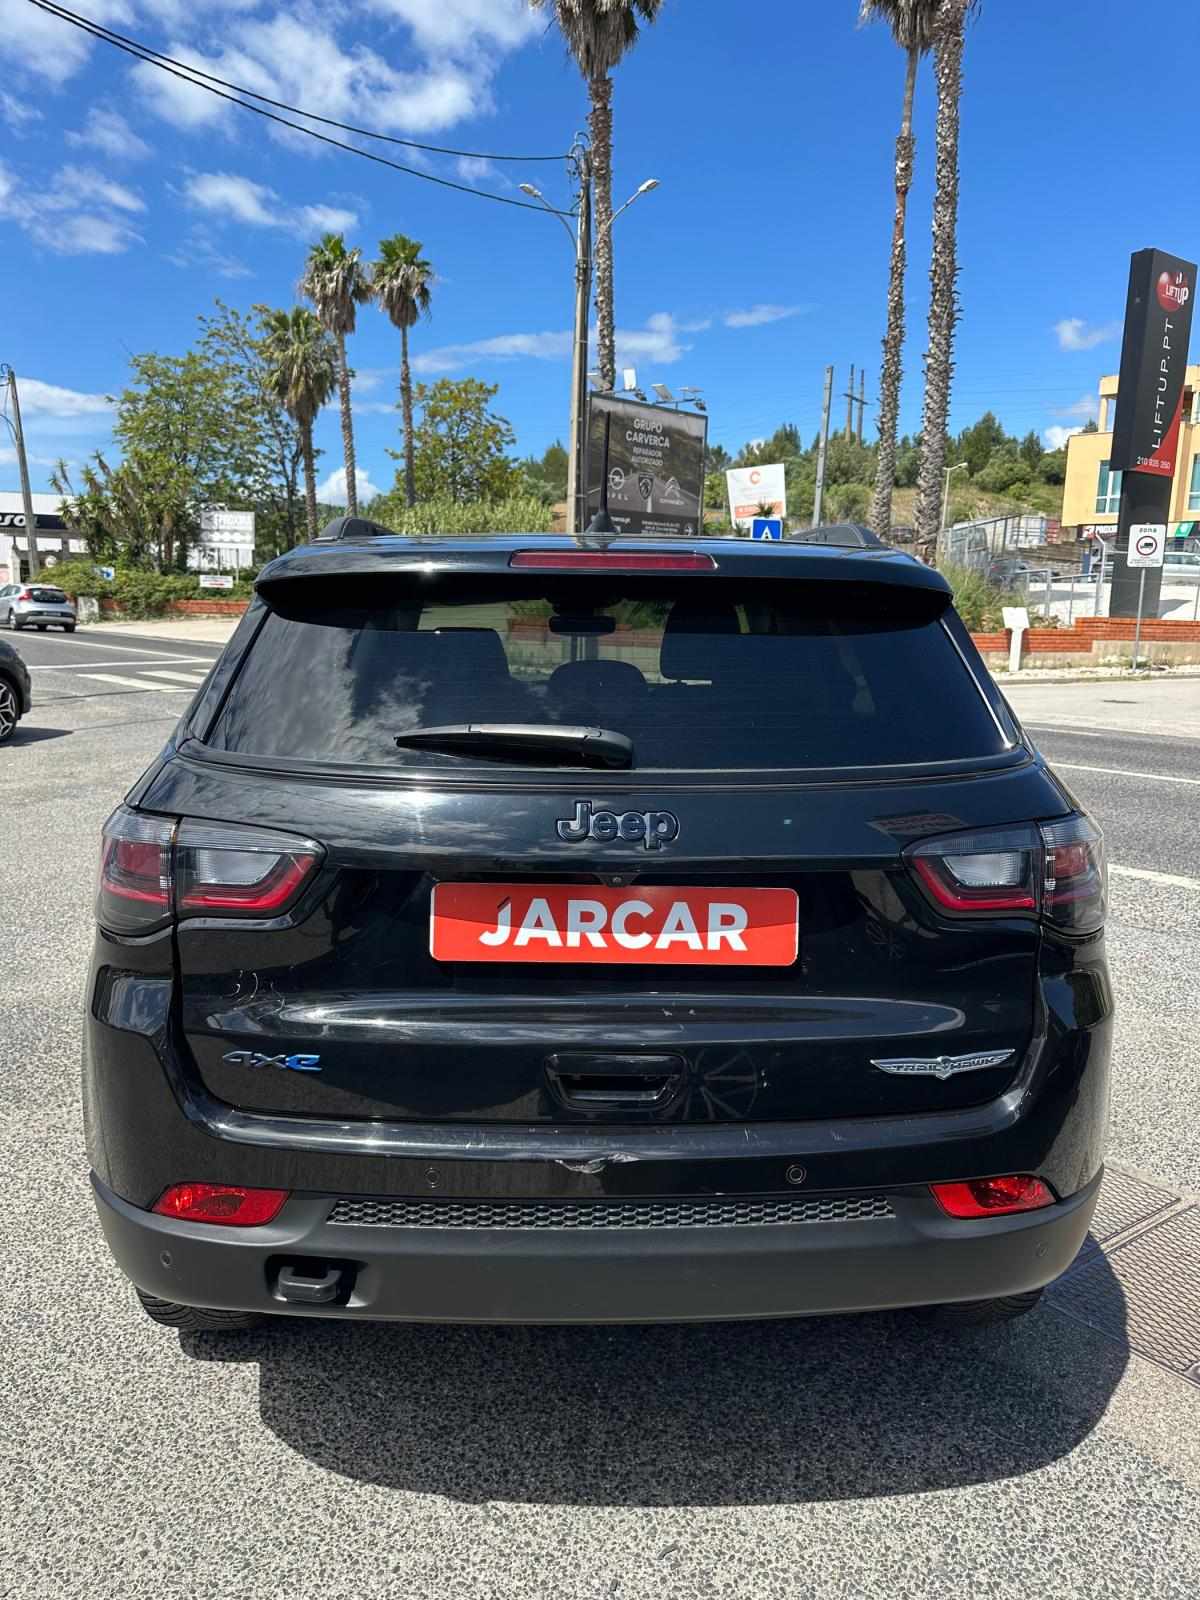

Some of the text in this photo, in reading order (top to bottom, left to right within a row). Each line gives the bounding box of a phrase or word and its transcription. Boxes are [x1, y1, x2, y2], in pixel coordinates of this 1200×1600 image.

[1166, 284, 1189, 305] LIFTUP
[1151, 317, 1174, 449] LIFTUP.PT
[625, 430, 670, 448] CARVERCA
[633, 418, 663, 433] GRUPO
[557, 800, 680, 849] Jeep
[478, 896, 749, 951] JARCAR
